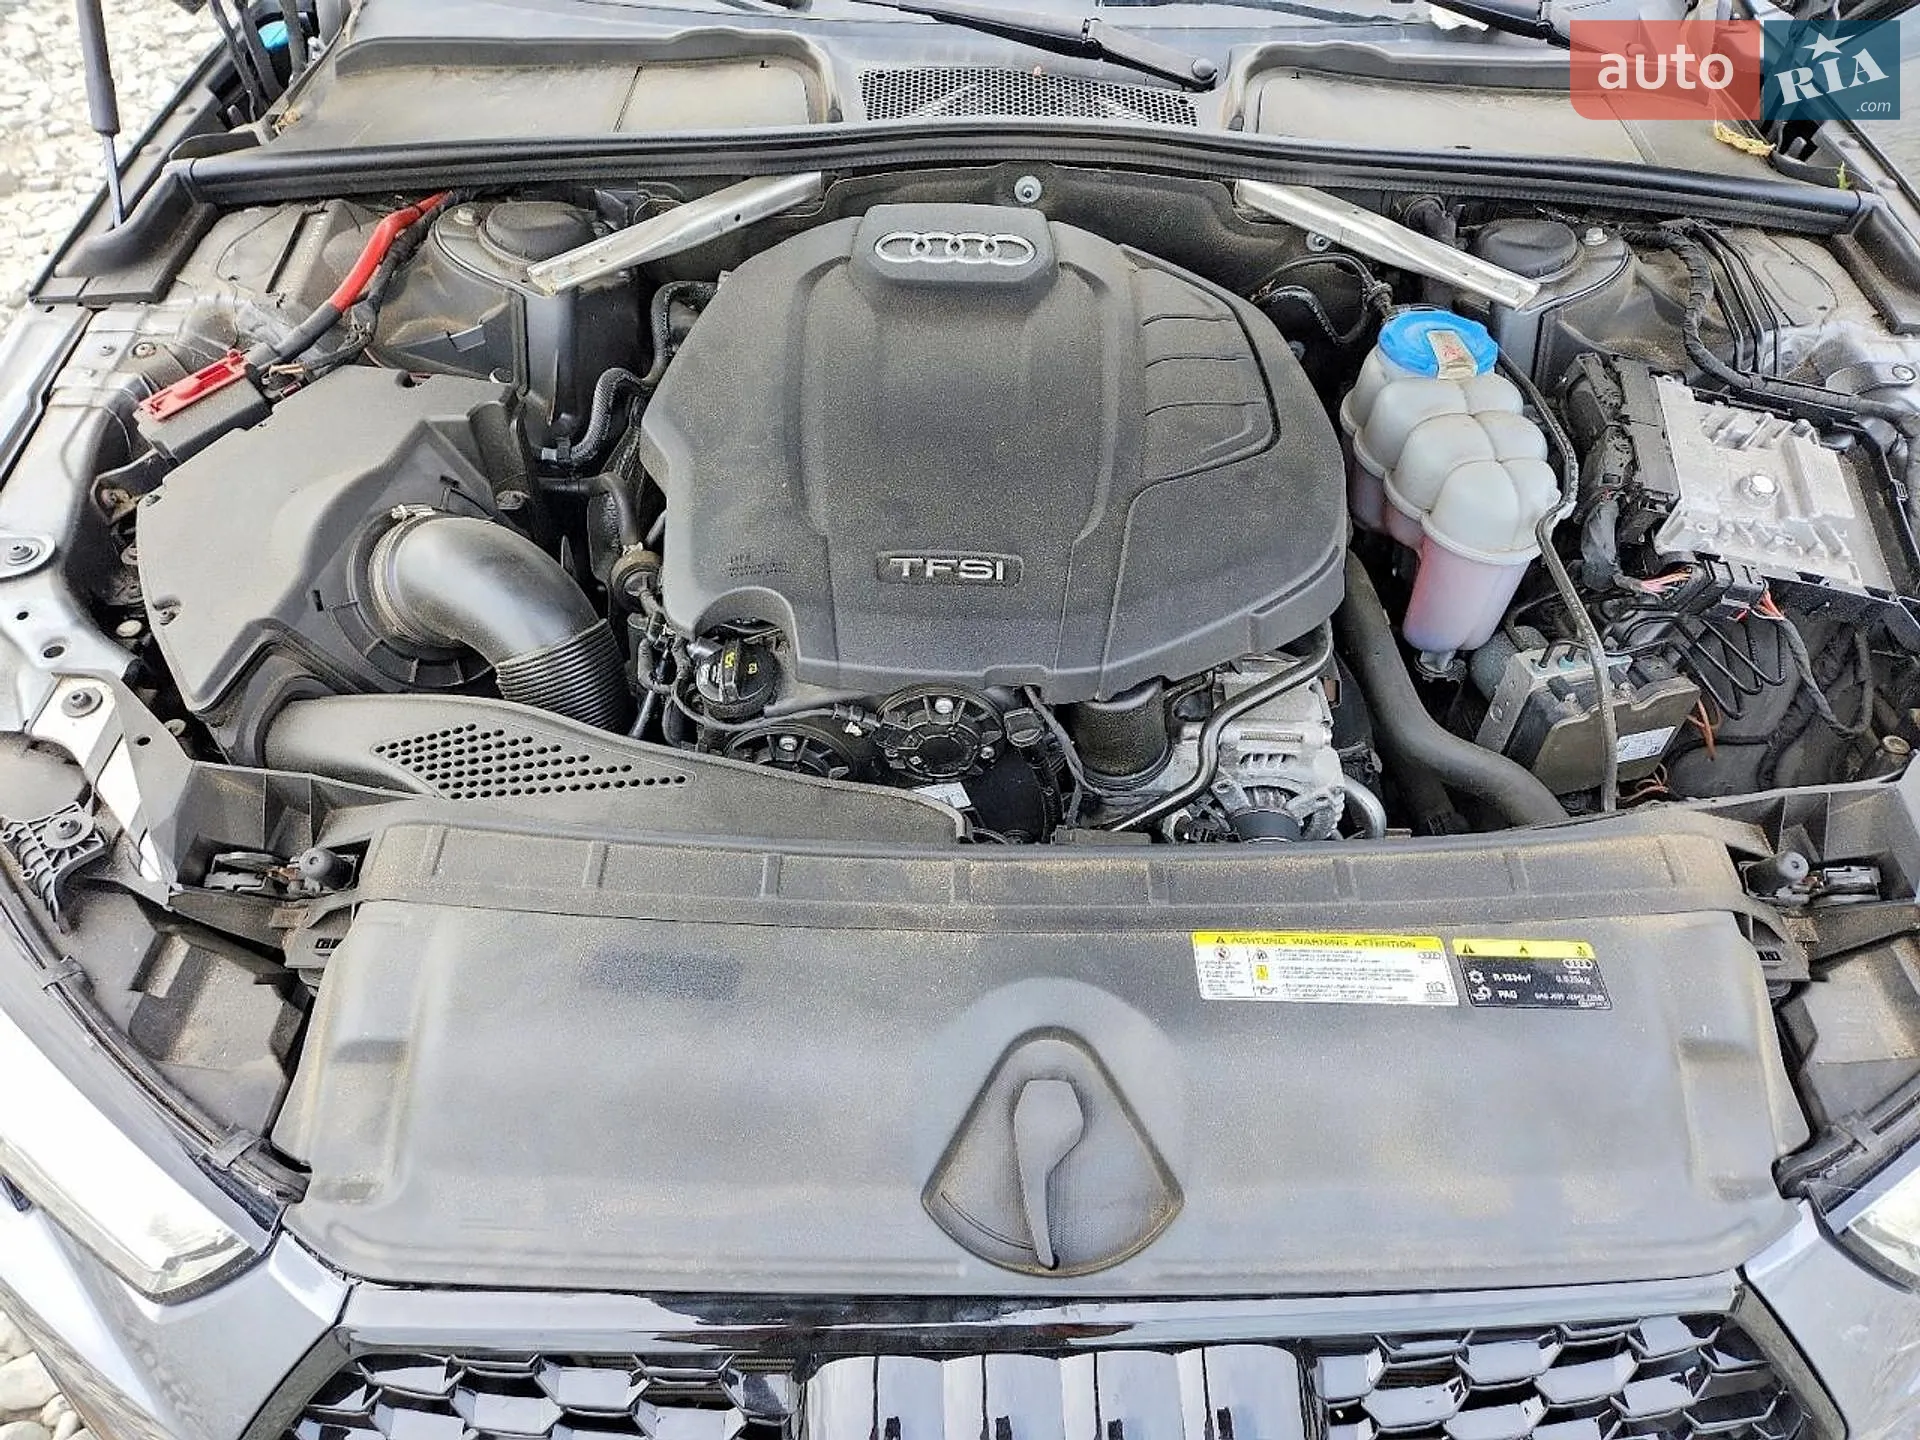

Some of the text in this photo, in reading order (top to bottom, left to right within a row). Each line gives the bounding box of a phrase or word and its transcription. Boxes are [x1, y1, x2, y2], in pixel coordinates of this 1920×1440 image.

[890, 557, 1004, 580] TFSI
[1231, 936, 1417, 949] ACHTUNG WARNING ATTENTION
